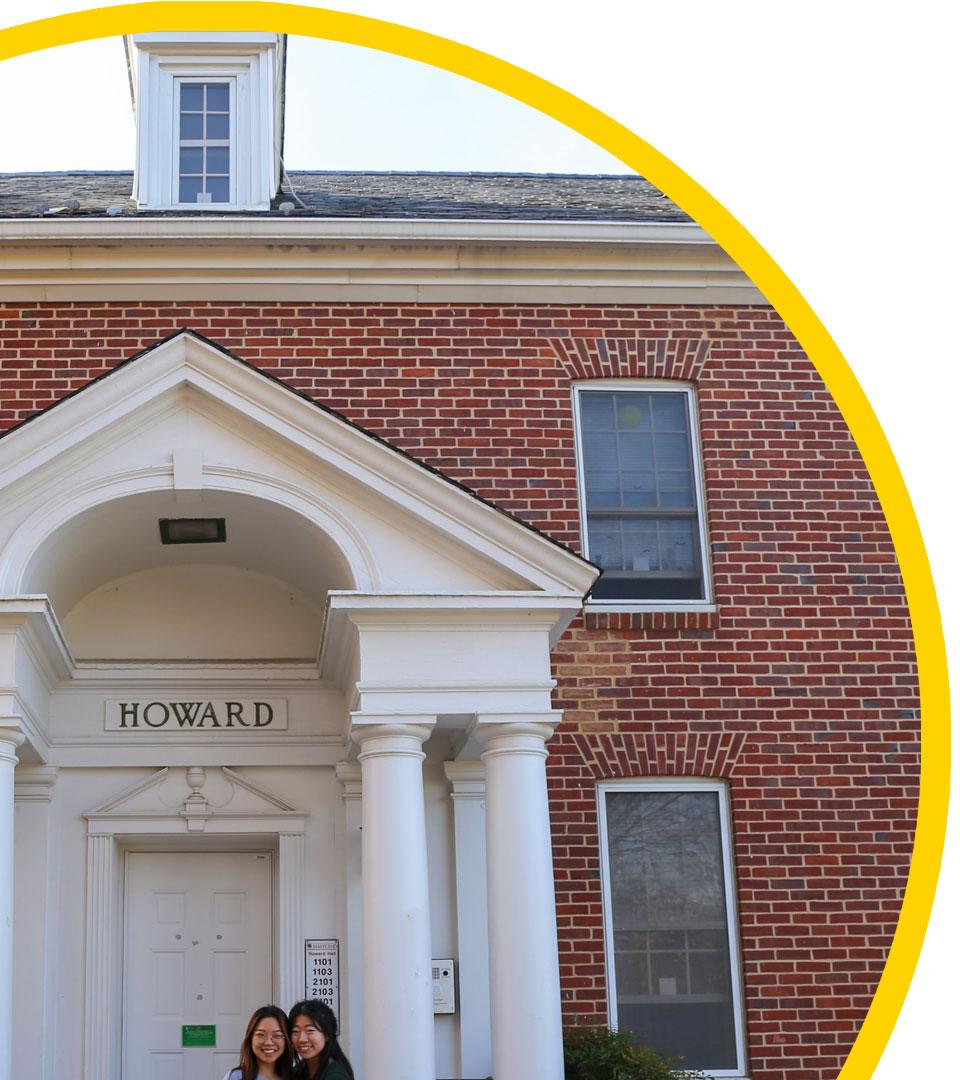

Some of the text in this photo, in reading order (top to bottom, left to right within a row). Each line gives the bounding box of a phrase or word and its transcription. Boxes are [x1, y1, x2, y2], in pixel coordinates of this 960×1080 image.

[119, 702, 273, 728] HOWARD
[313, 958, 332, 966] 1101
[313, 968, 333, 976] 1103
[312, 978, 333, 986] 2101
[312, 988, 333, 996] 2103
